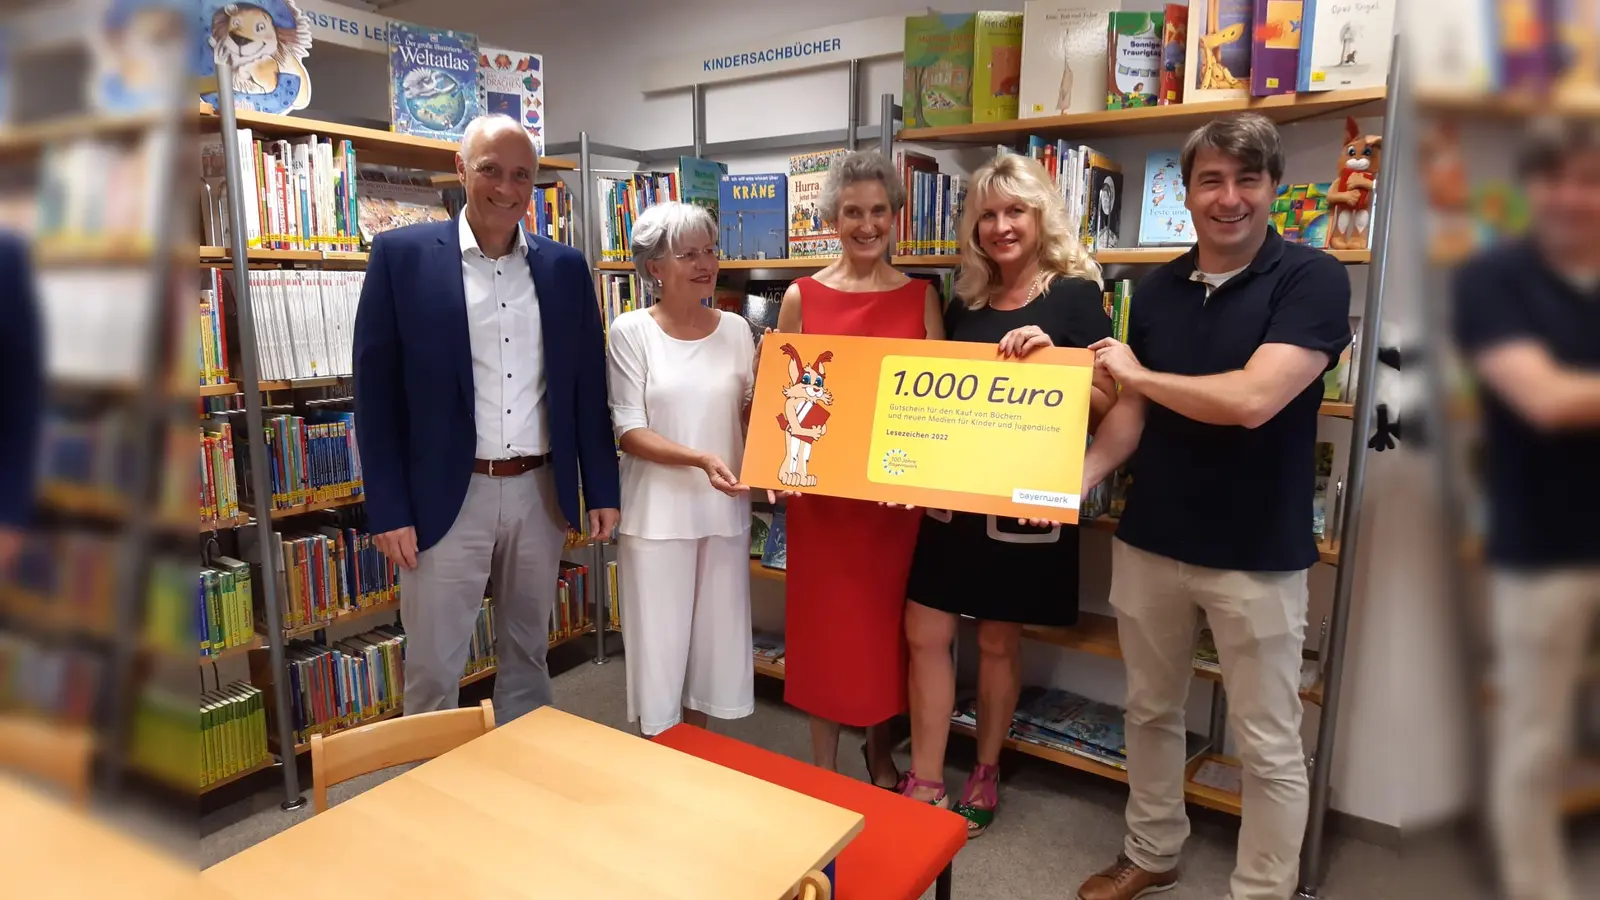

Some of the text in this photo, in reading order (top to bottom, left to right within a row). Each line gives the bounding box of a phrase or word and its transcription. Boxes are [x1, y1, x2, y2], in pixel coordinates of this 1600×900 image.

[302, 10, 359, 35] RSTES
[399, 45, 470, 72] Weltatlas
[703, 38, 841, 71] KINDERSACHBÜCHER
[732, 183, 776, 200] KRÄNE
[759, 291, 784, 304] NAC
[893, 370, 1064, 408] 1.000 Euro
[889, 403, 925, 413] Gutschein
[927, 406, 937, 414] für
[939, 407, 953, 415] den
[955, 408, 973, 417] Kauf
[990, 411, 1022, 421] Büchern
[888, 412, 902, 420] und
[903, 413, 926, 422] neuen
[928, 415, 956, 424] Medien
[957, 418, 969, 426] für
[970, 419, 996, 427] Kinder
[1014, 422, 1061, 433] Jugendliche
[886, 428, 949, 441] Lesezeichen 2022
[1018, 491, 1069, 504] bayernwerk
